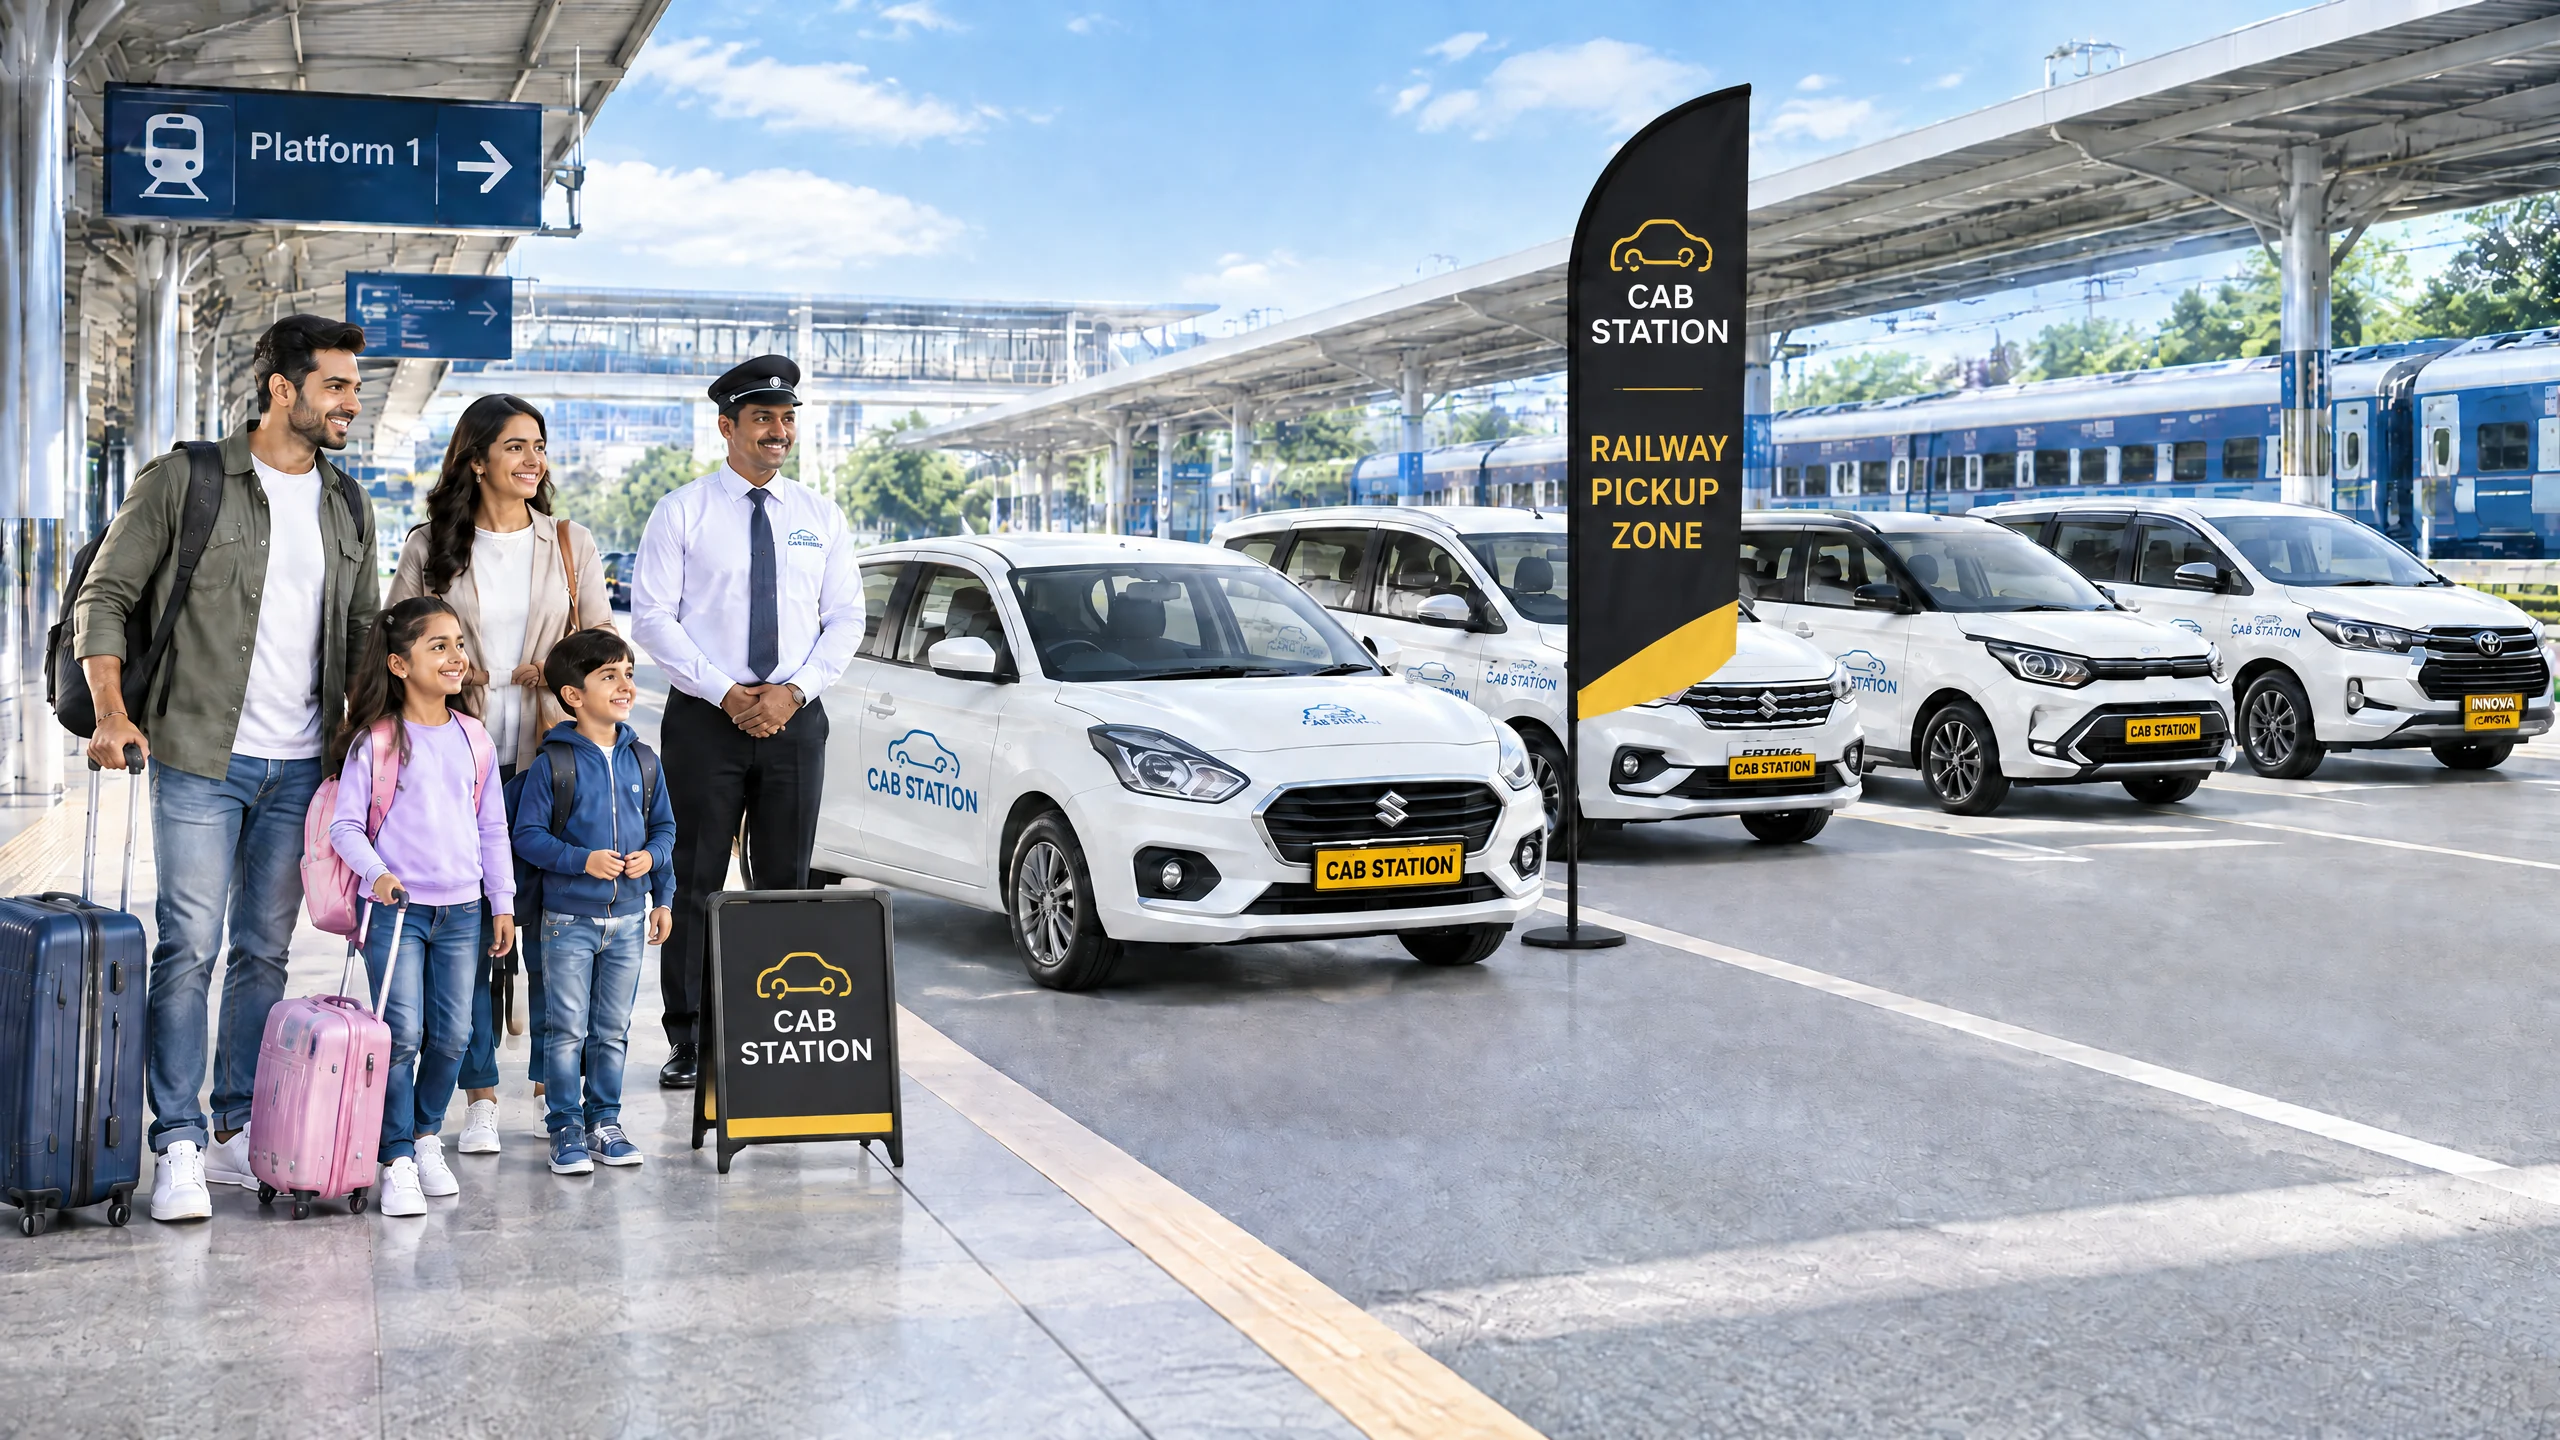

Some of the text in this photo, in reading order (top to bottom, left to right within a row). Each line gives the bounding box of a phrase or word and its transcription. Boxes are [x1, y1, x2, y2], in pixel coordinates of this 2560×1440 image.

[251, 131, 419, 166] Platform 1
[1628, 284, 1694, 309] CAB
[1591, 318, 1729, 344] STATION
[1591, 435, 1729, 462] RAILWAY
[1591, 477, 1719, 505] PICKUP
[1611, 521, 1703, 549] ZONE
[2231, 624, 2301, 638] CAB STATION
[1486, 671, 1557, 691] CAB STATION
[2472, 697, 2515, 711] INNOVA
[2130, 722, 2197, 738] CAB STATION
[1735, 760, 1811, 775] CAB STATION
[867, 767, 978, 814] CAB STATION
[1326, 855, 1454, 881] CAB STATION
[773, 1008, 837, 1033] CAB
[740, 1038, 873, 1065] STATION
